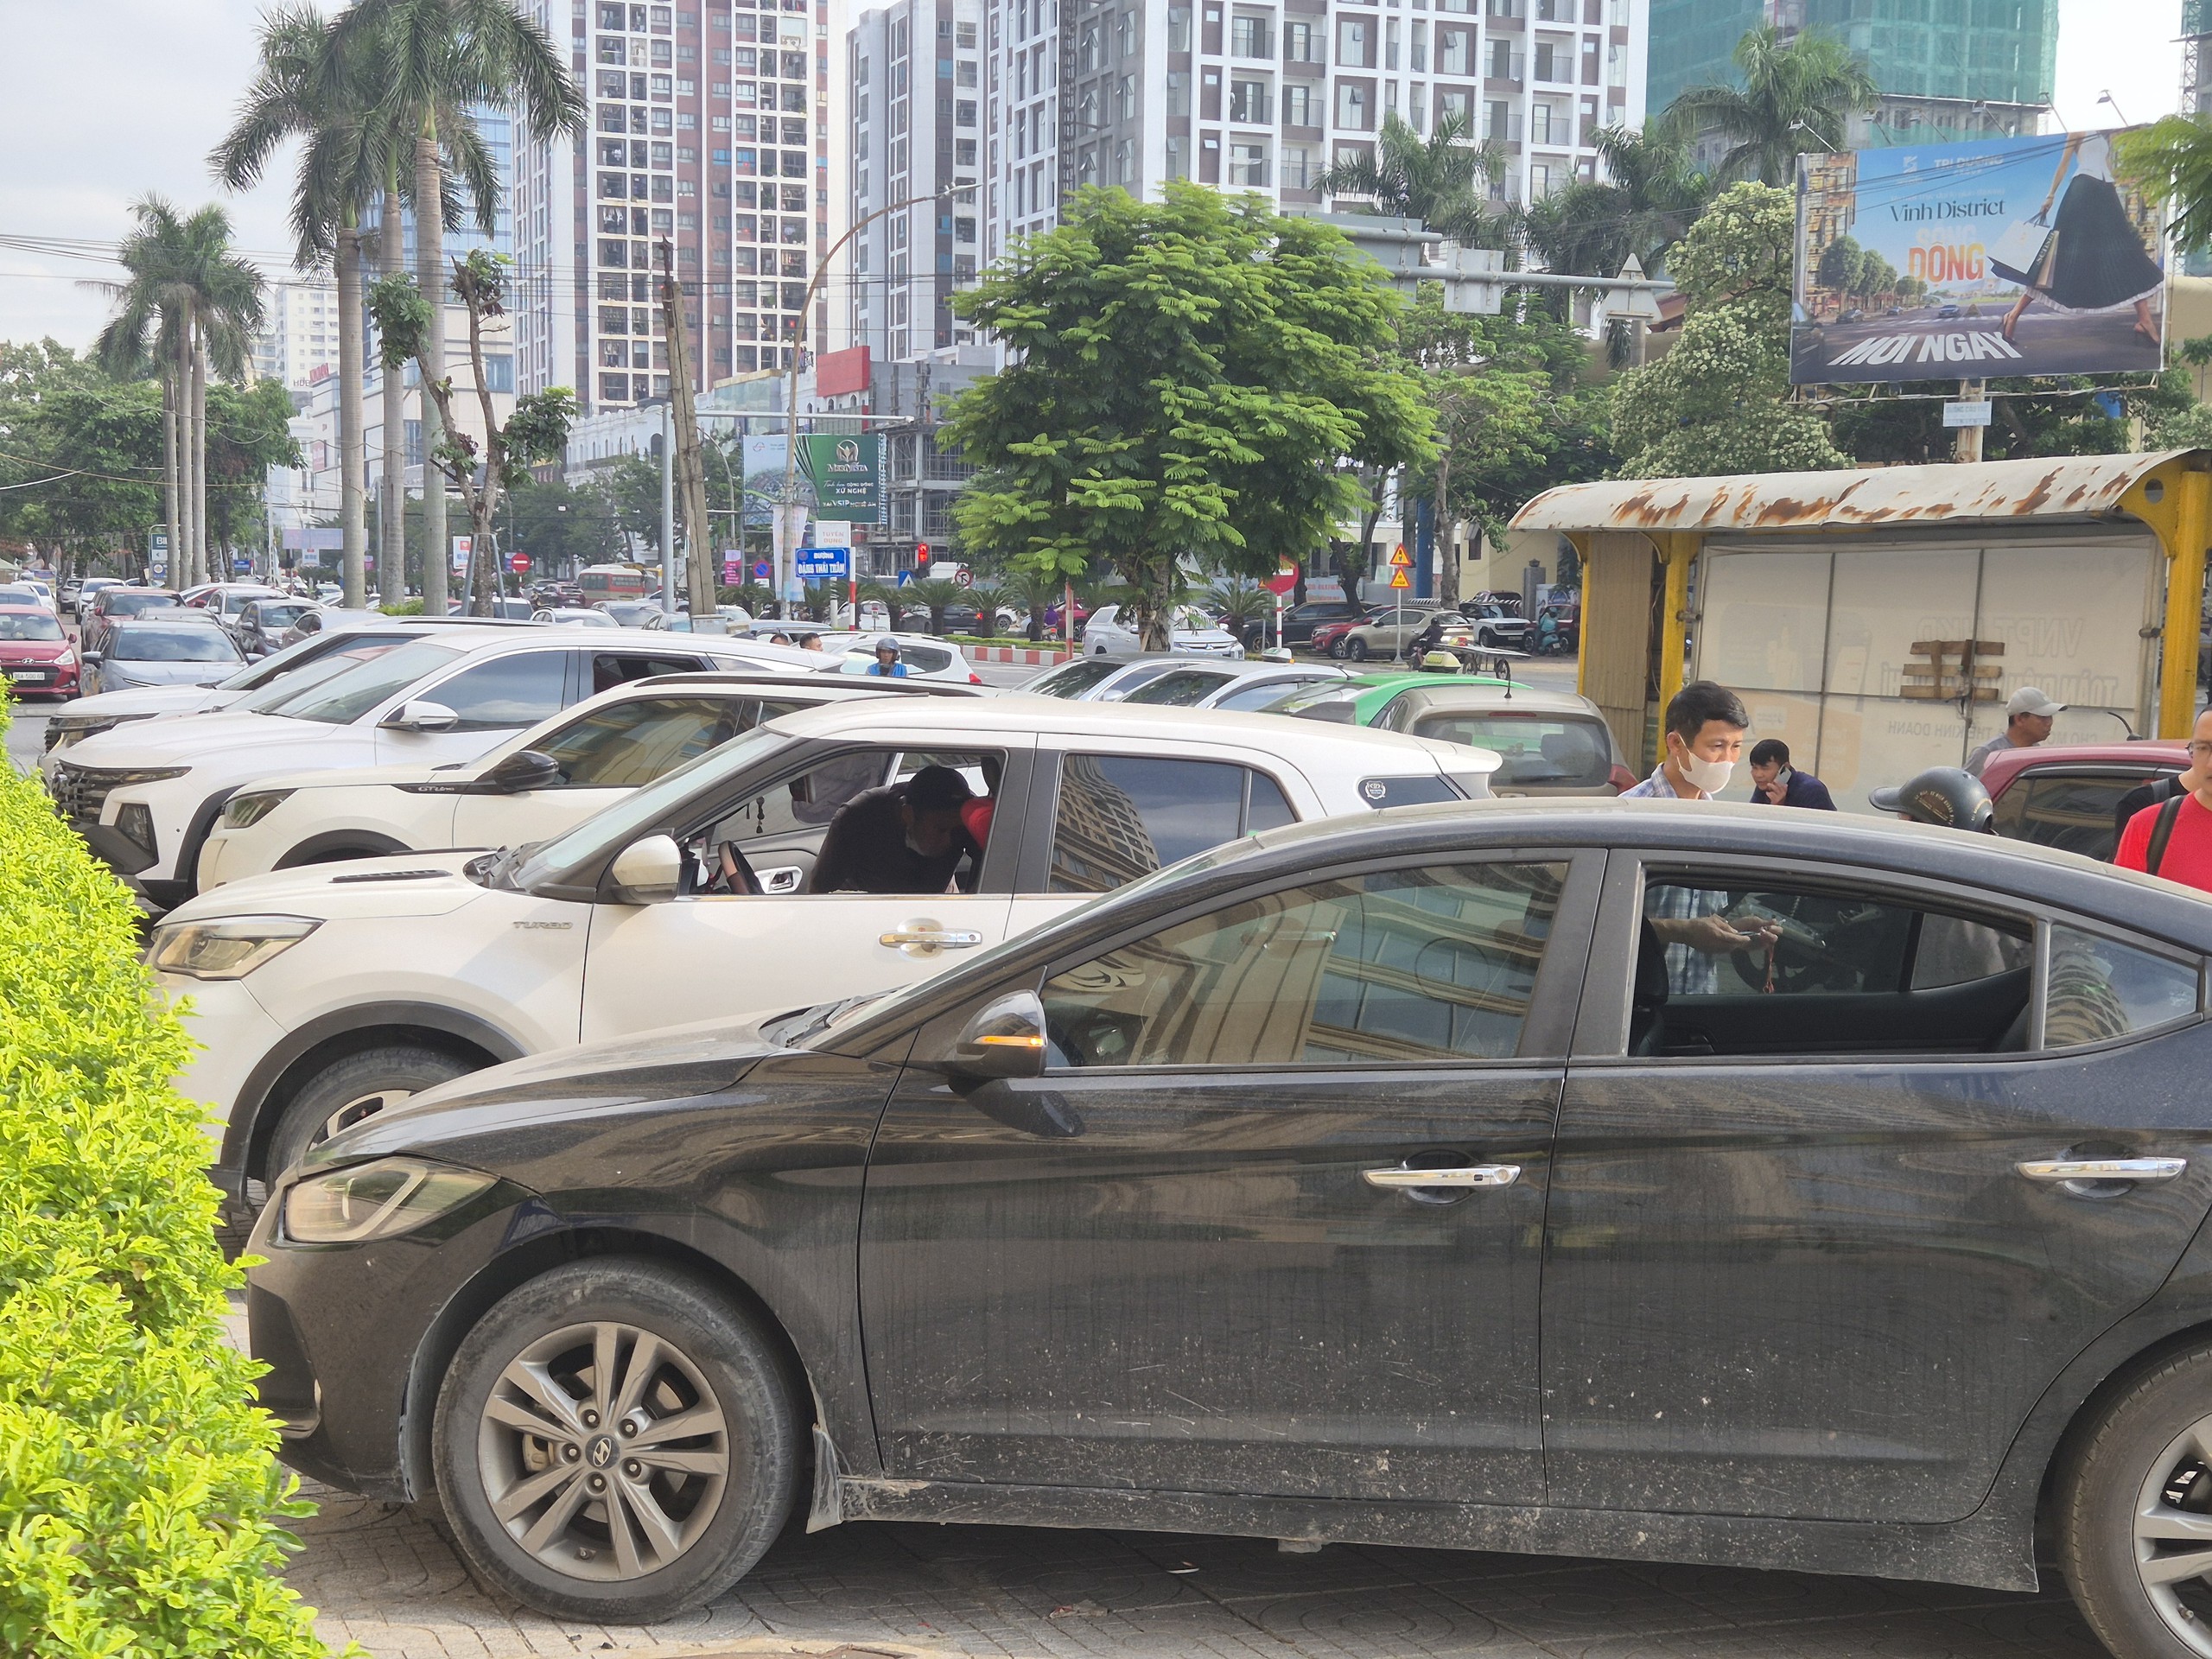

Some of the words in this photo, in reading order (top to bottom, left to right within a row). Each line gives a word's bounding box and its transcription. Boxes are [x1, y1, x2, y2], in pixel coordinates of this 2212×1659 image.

[1890, 202, 1933, 222] Vinh
[1937, 198, 2005, 219] District
[1916, 330, 2023, 363] NGÀY
[512, 921, 574, 930] TURBO
